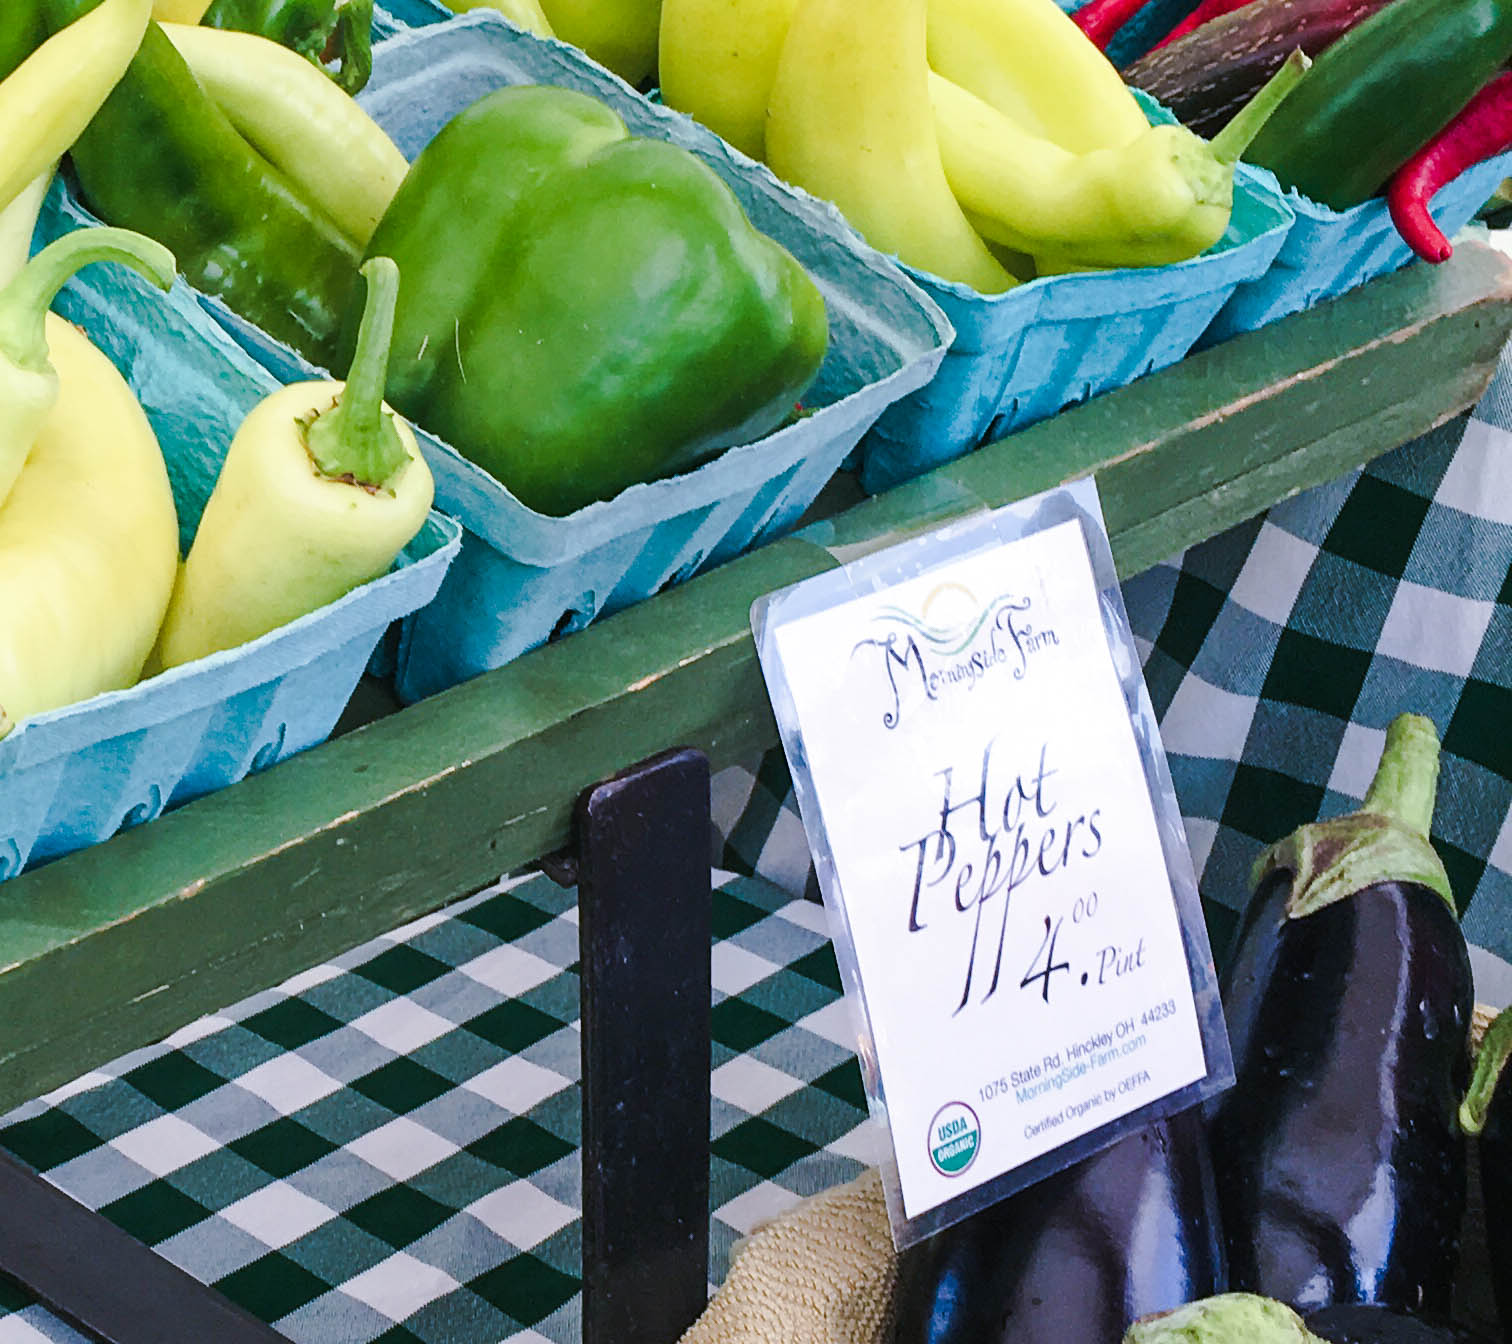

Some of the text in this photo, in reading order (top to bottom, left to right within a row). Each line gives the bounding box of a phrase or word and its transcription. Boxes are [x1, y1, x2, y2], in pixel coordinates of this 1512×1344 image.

[996, 596, 1060, 680] Farm
[933, 732, 1059, 862] Hot
[899, 809, 1101, 1017] Peppers
[1096, 937, 1146, 984] Pint
[979, 1079, 1009, 1103] 1075
[1011, 1064, 1041, 1088] State
[1067, 1030, 1113, 1062] Hinckley
[1116, 1018, 1135, 1039] OH
[1141, 999, 1176, 1026] 44233
[938, 1117, 967, 1141] USDA
[1024, 1070, 1151, 1139] Certified Organic by OEFFA
[937, 1135, 974, 1162] ORGANIC
